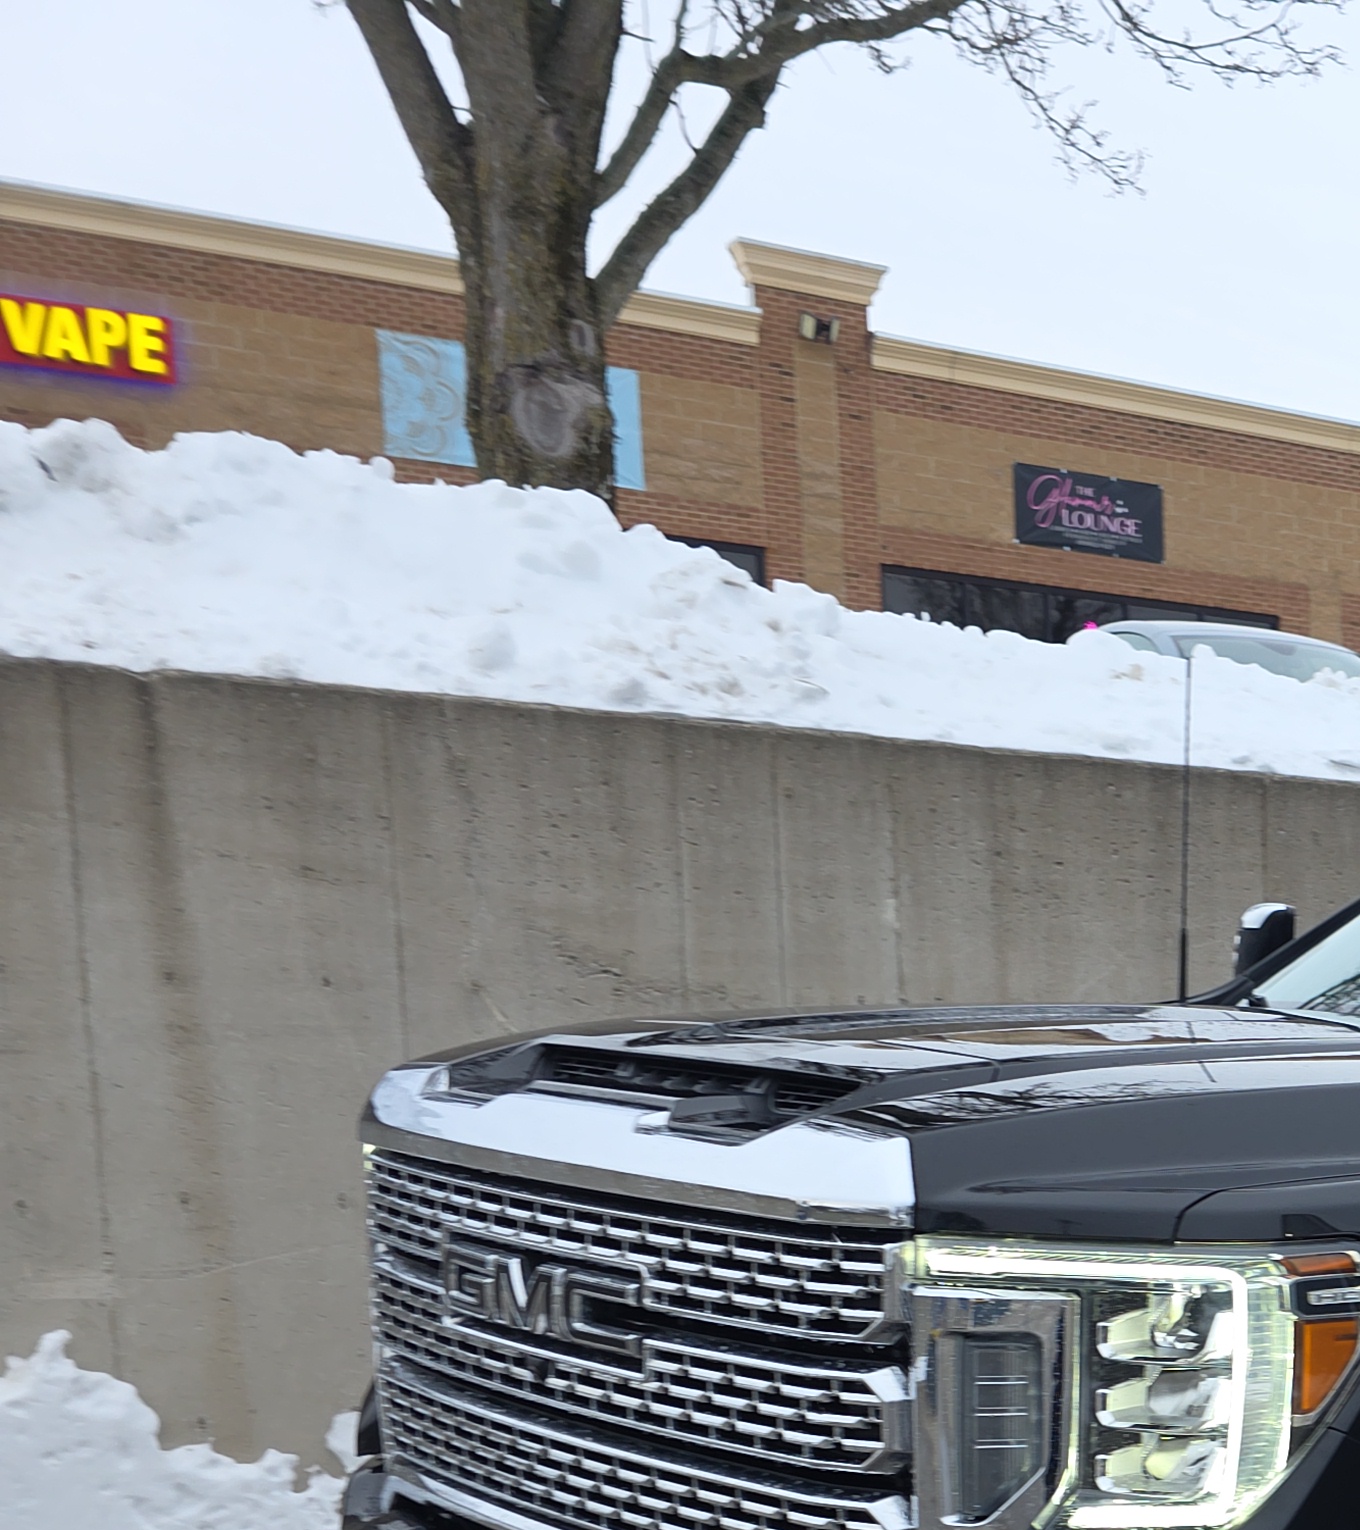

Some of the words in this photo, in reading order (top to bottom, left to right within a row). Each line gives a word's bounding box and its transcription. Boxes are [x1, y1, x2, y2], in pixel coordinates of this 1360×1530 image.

[0, 298, 169, 374] VAPE
[1061, 509, 1143, 537] LOUNGE
[440, 1240, 642, 1358] GMC
